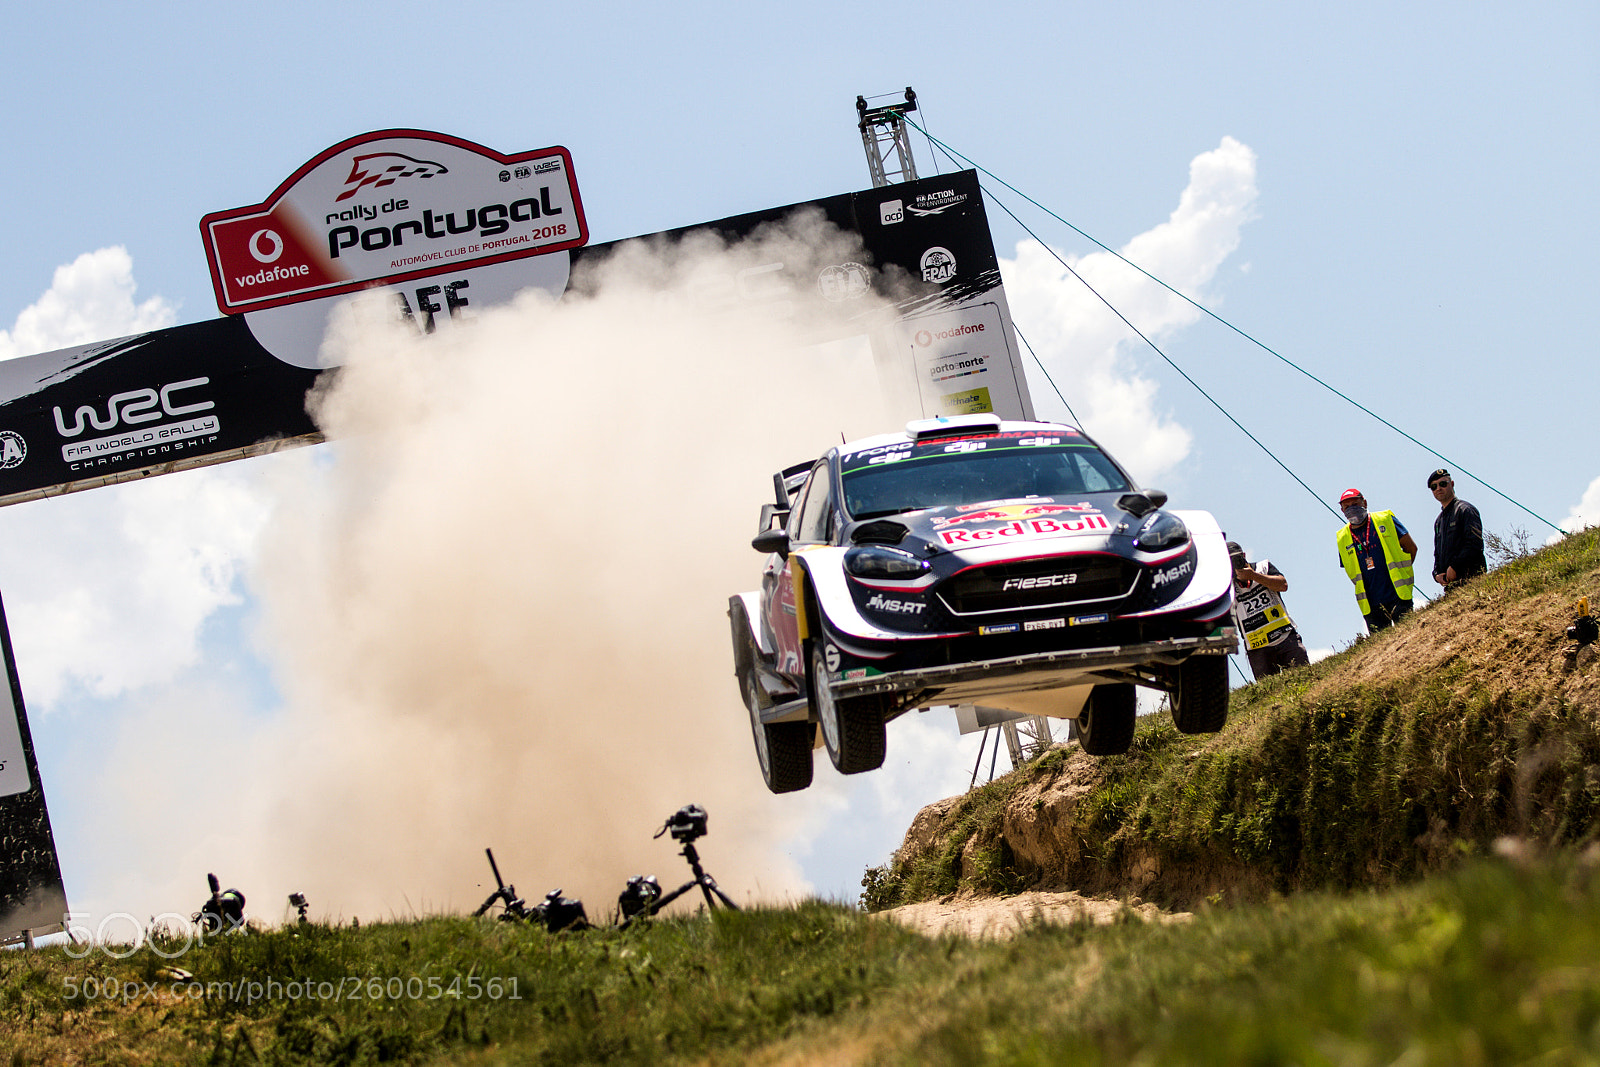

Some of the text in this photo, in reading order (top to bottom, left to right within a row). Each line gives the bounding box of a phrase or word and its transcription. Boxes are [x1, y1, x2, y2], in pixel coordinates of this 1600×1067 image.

[514, 167, 531, 178] FIA
[927, 189, 955, 201] ACTION
[325, 197, 409, 224] rally de
[328, 187, 562, 258] Portugal
[884, 212, 903, 221] acp
[390, 223, 567, 269] AUTOMÓVEL CLUB DE PORTUGAL 2018
[235, 263, 309, 288] vodafone
[819, 268, 868, 295] FIA
[922, 262, 957, 282] FPAK
[934, 323, 985, 340] vodafone
[53, 376, 215, 437] WRC
[67, 421, 214, 457] FIA WORLD RALLY
[857, 442, 914, 458] FORD
[70, 435, 218, 471] CHAMPIONSHIP
[941, 515, 1108, 545] Red Bull
[875, 599, 927, 614] MS-RT
[1243, 592, 1270, 613] 228
